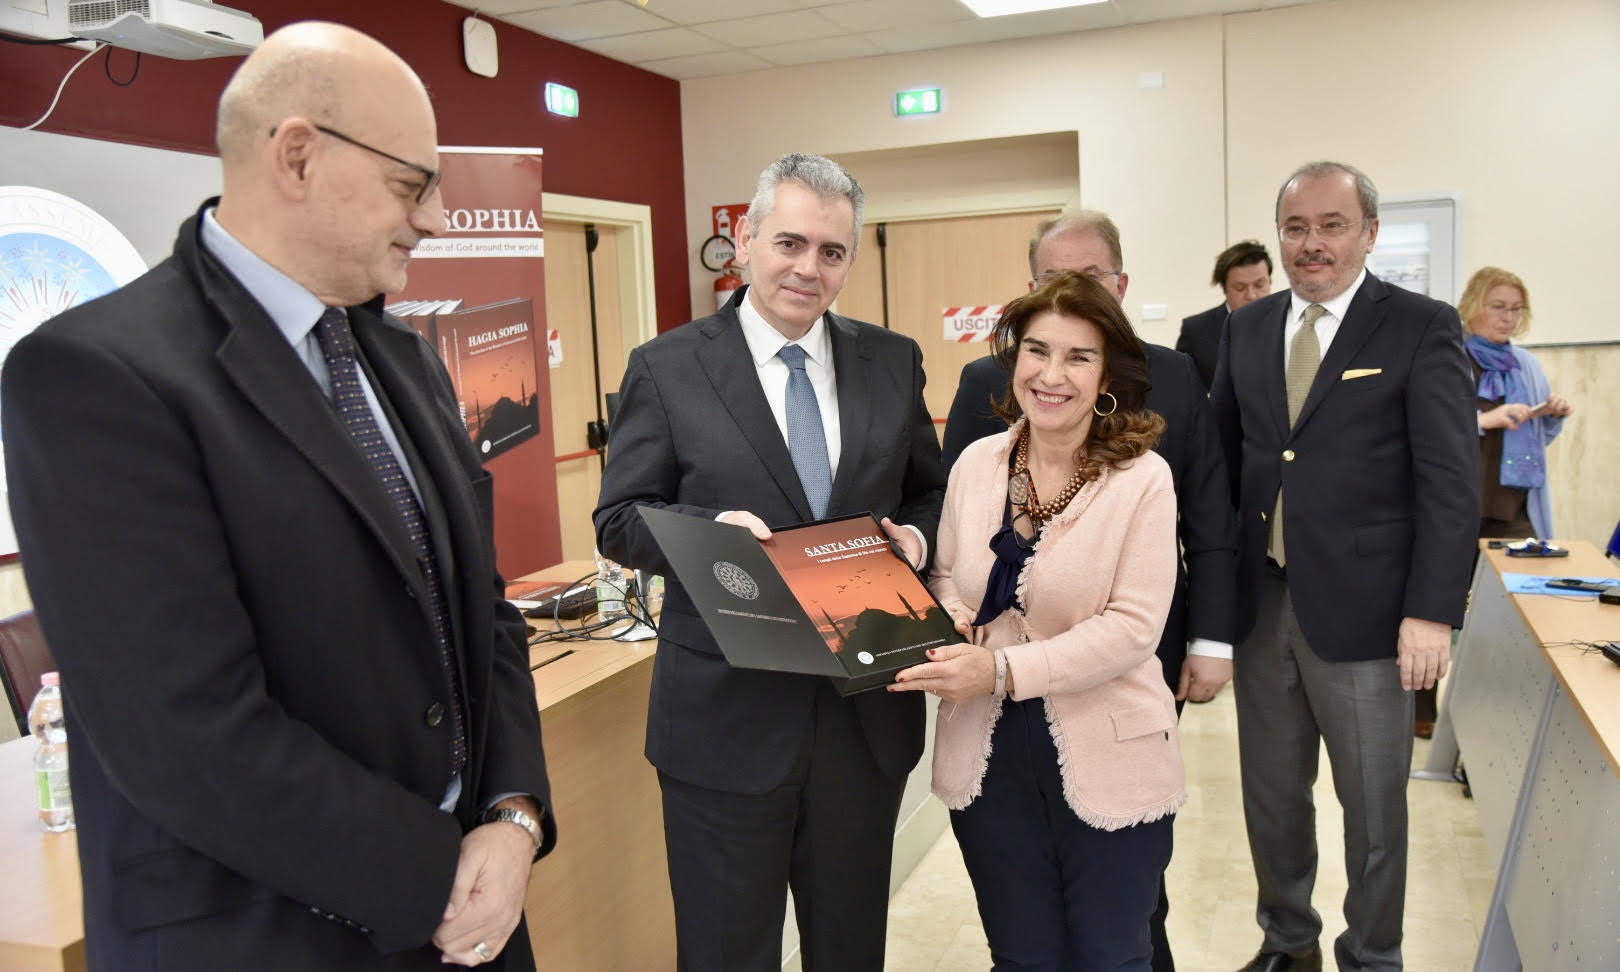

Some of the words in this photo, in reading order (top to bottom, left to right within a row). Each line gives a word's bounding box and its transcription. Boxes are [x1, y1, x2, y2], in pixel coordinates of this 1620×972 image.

[445, 243, 454, 251] of
[456, 243, 473, 251] God
[475, 243, 501, 251] around
[504, 243, 516, 251] the
[519, 243, 539, 251] world
[954, 317, 998, 331] USCIT
[468, 333, 498, 347] HAGIA
[498, 322, 529, 339] SOPHIA
[805, 542, 847, 557] SANTA
[847, 535, 885, 548] SOFIA
